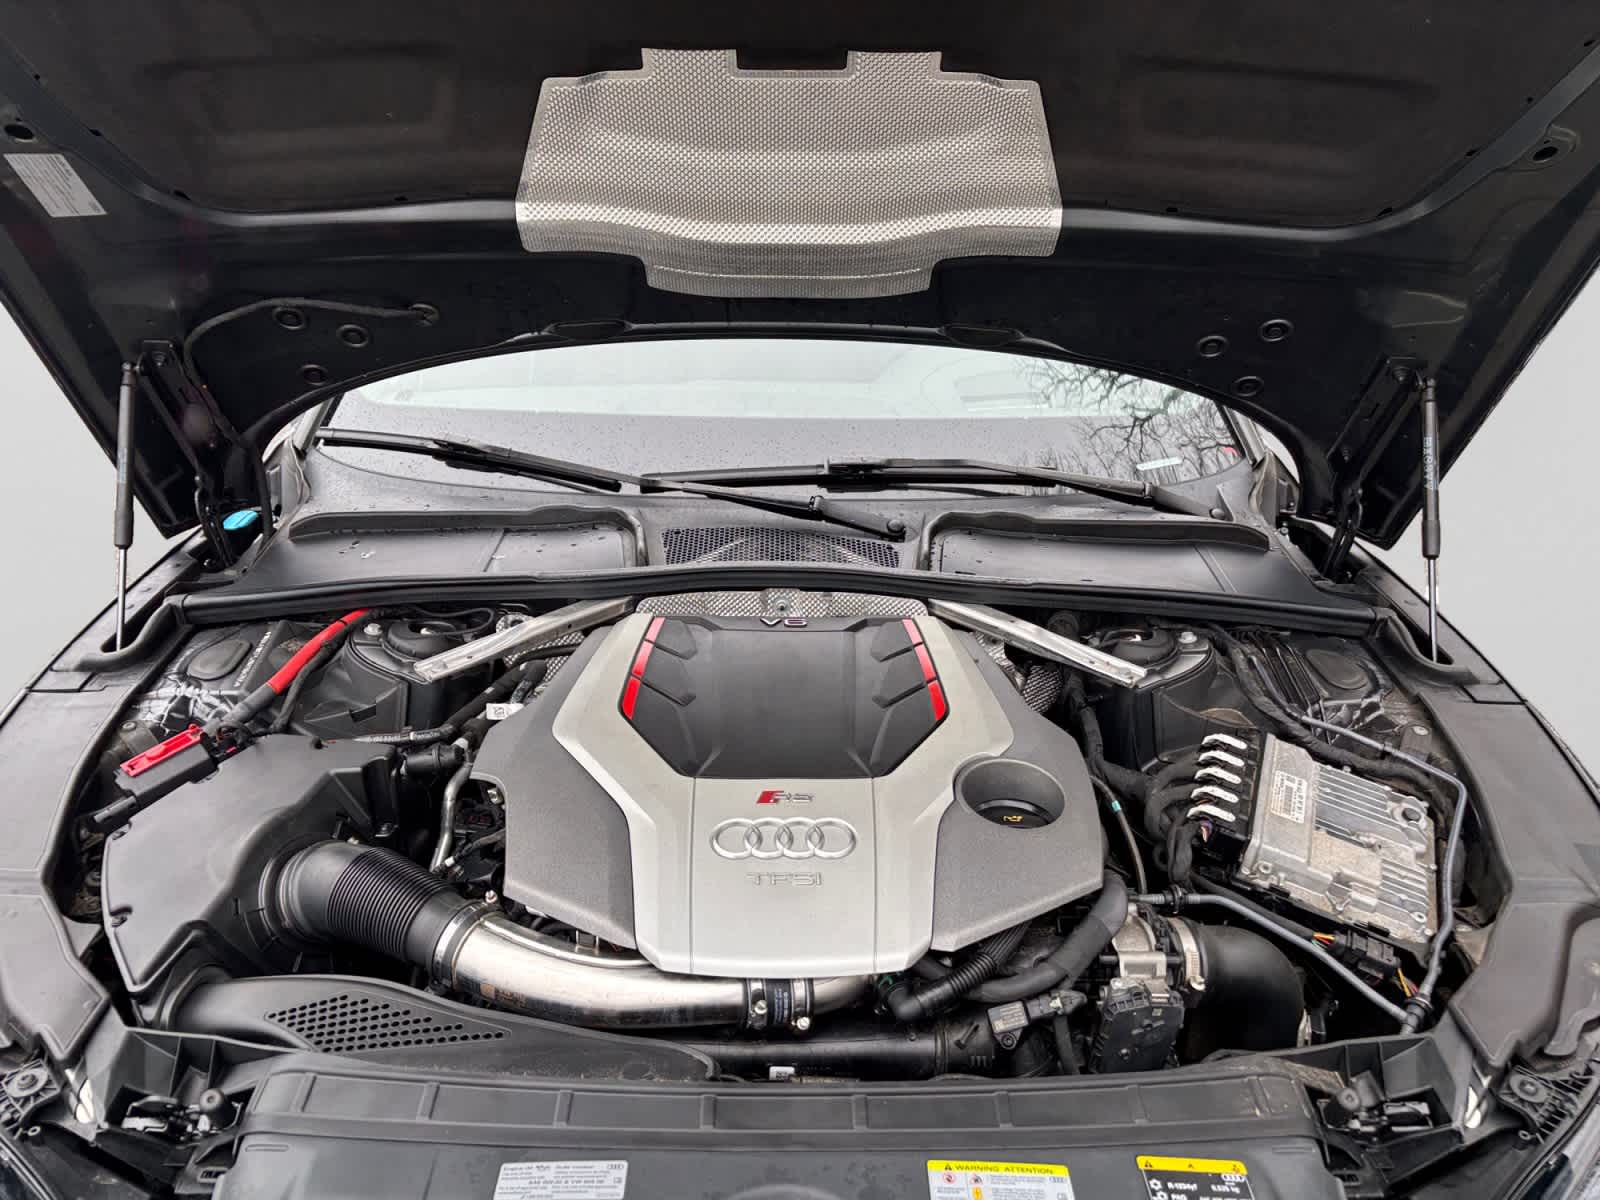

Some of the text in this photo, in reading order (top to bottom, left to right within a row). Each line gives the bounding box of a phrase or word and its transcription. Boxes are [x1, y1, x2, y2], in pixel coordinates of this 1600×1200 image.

[745, 872, 823, 886] TFSI
[955, 1165, 1053, 1175] WARNING ATTENTION
